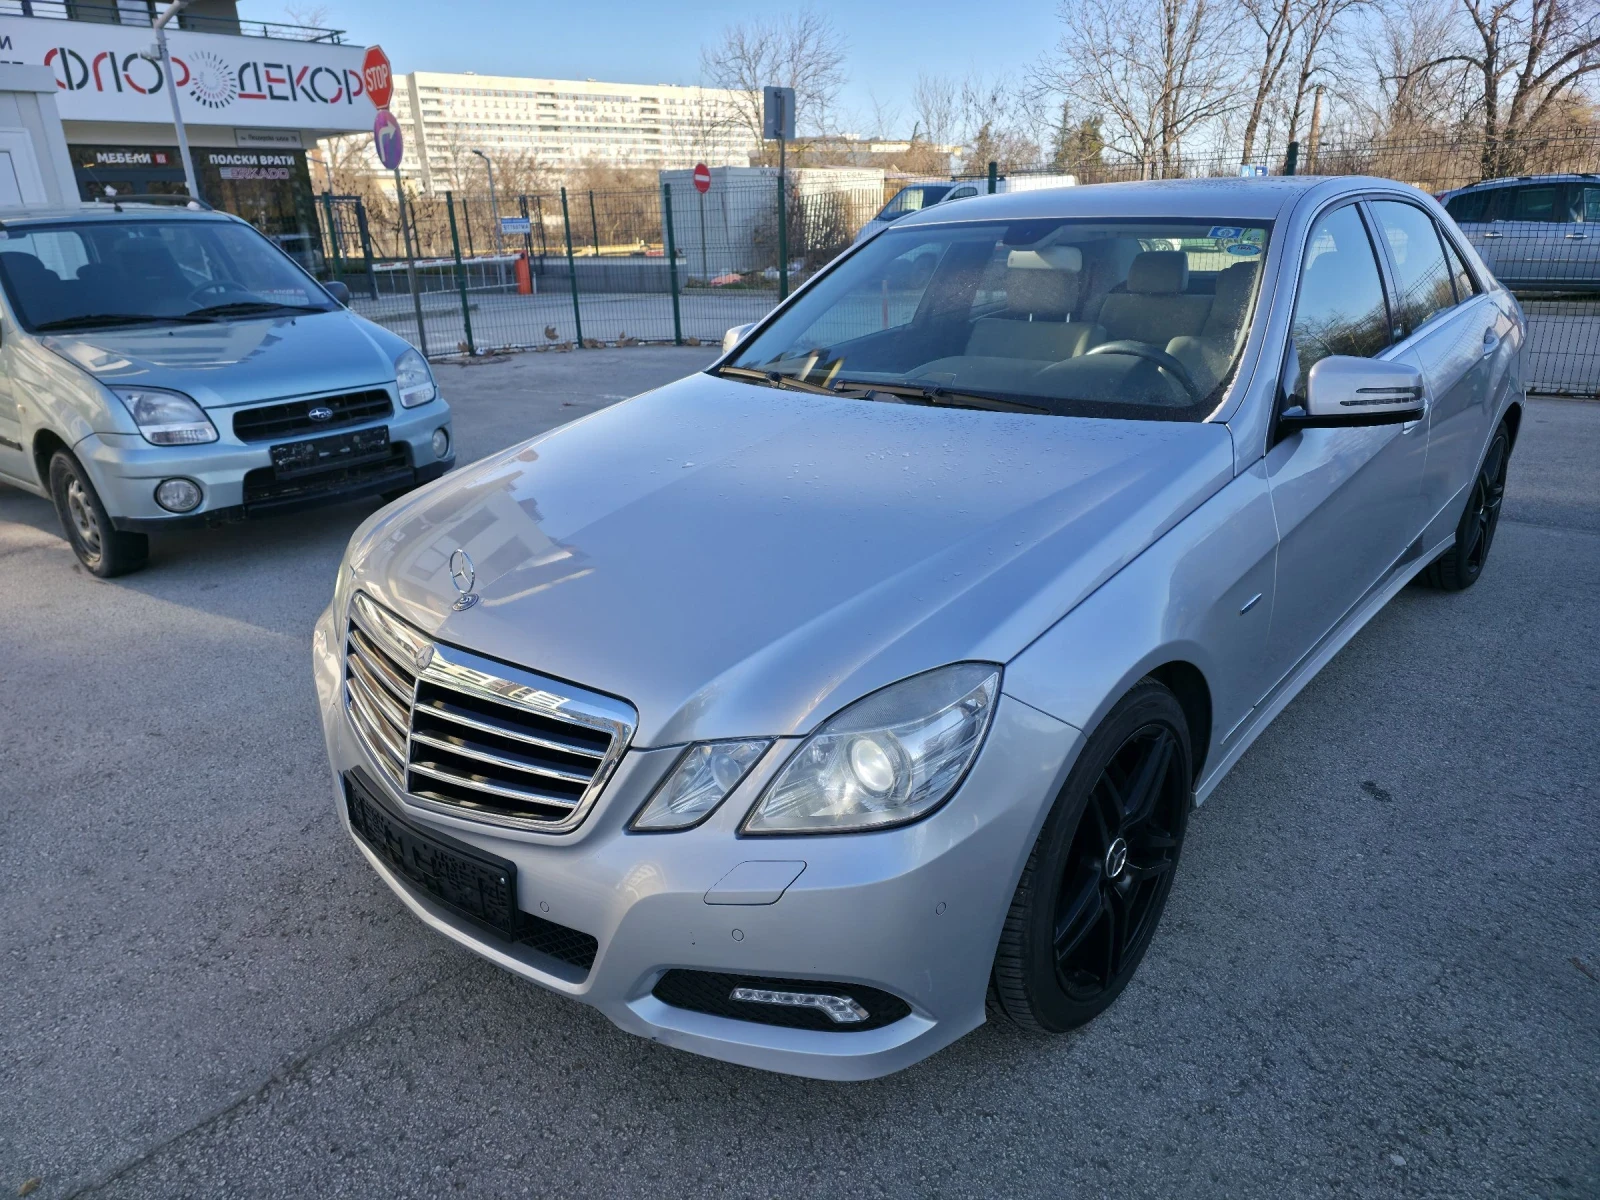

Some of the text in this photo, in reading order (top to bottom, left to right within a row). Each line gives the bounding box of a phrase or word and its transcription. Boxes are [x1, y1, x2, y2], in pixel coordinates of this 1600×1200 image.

[238, 61, 363, 105] ДЕКОР
[366, 63, 388, 91] STOP
[96, 152, 152, 164] МЕБЕЛИ
[209, 154, 295, 166] ПОЛСКИ ВРАТИ
